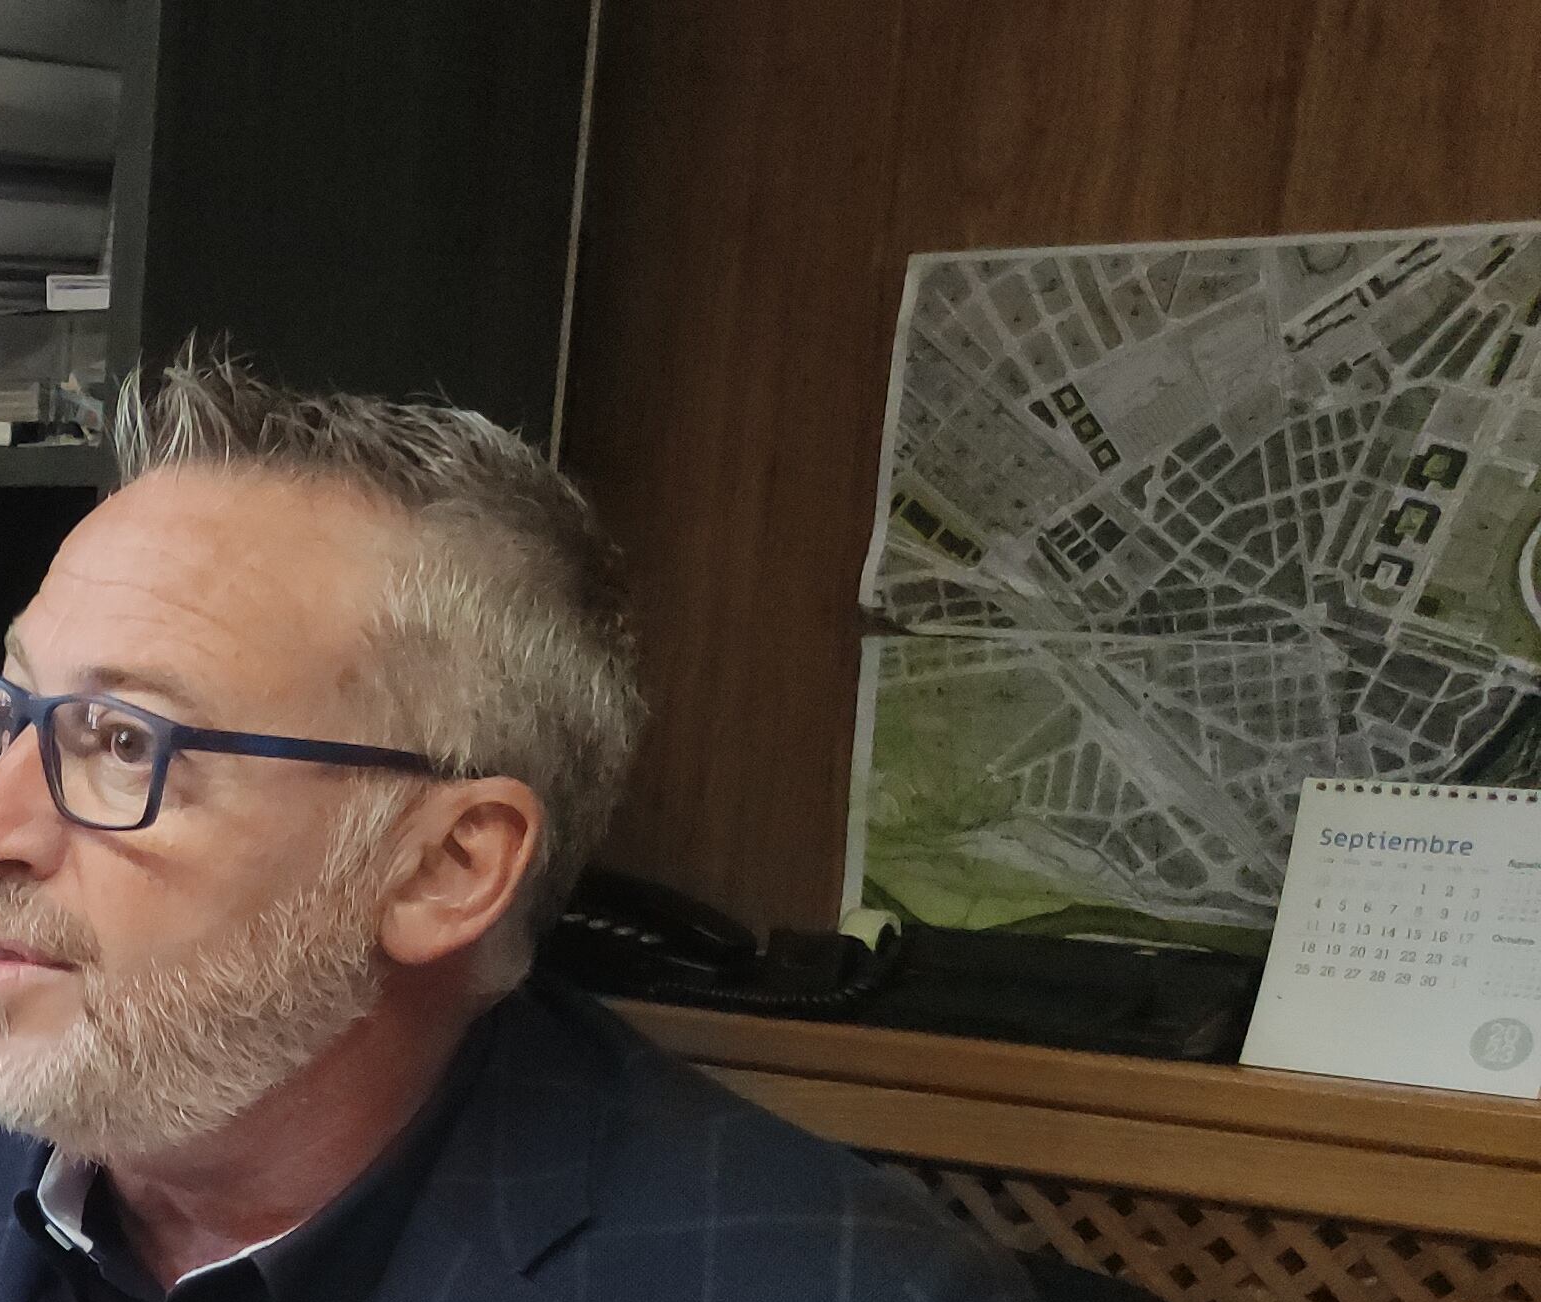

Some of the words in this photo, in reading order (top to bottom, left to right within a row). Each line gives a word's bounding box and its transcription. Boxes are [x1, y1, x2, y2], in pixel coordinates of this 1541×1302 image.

[1320, 828, 1473, 856] Septiembre
[1445, 885, 1454, 897] 2
[1338, 899, 1346, 911] 5
[1364, 902, 1371, 912] 6
[1389, 905, 1397, 914] 7
[1440, 908, 1449, 919] 9
[1331, 922, 1345, 934] 12
[1357, 924, 1370, 935] 13
[1381, 927, 1395, 938] 14
[1407, 928, 1421, 940] 15
[1432, 931, 1448, 942] 16
[1301, 942, 1316, 952] 18
[1326, 944, 1340, 955] 19
[1349, 946, 1365, 958] 20
[1374, 948, 1389, 960] 21
[1399, 951, 1416, 962] 22
[1425, 953, 1443, 964] 23
[1452, 956, 1470, 967] 24
[1295, 964, 1310, 975] 25
[1319, 966, 1335, 977] 26
[1344, 968, 1361, 979] 27
[1369, 971, 1386, 981] 28
[1395, 973, 1411, 984] 29
[1420, 975, 1436, 987] 30
